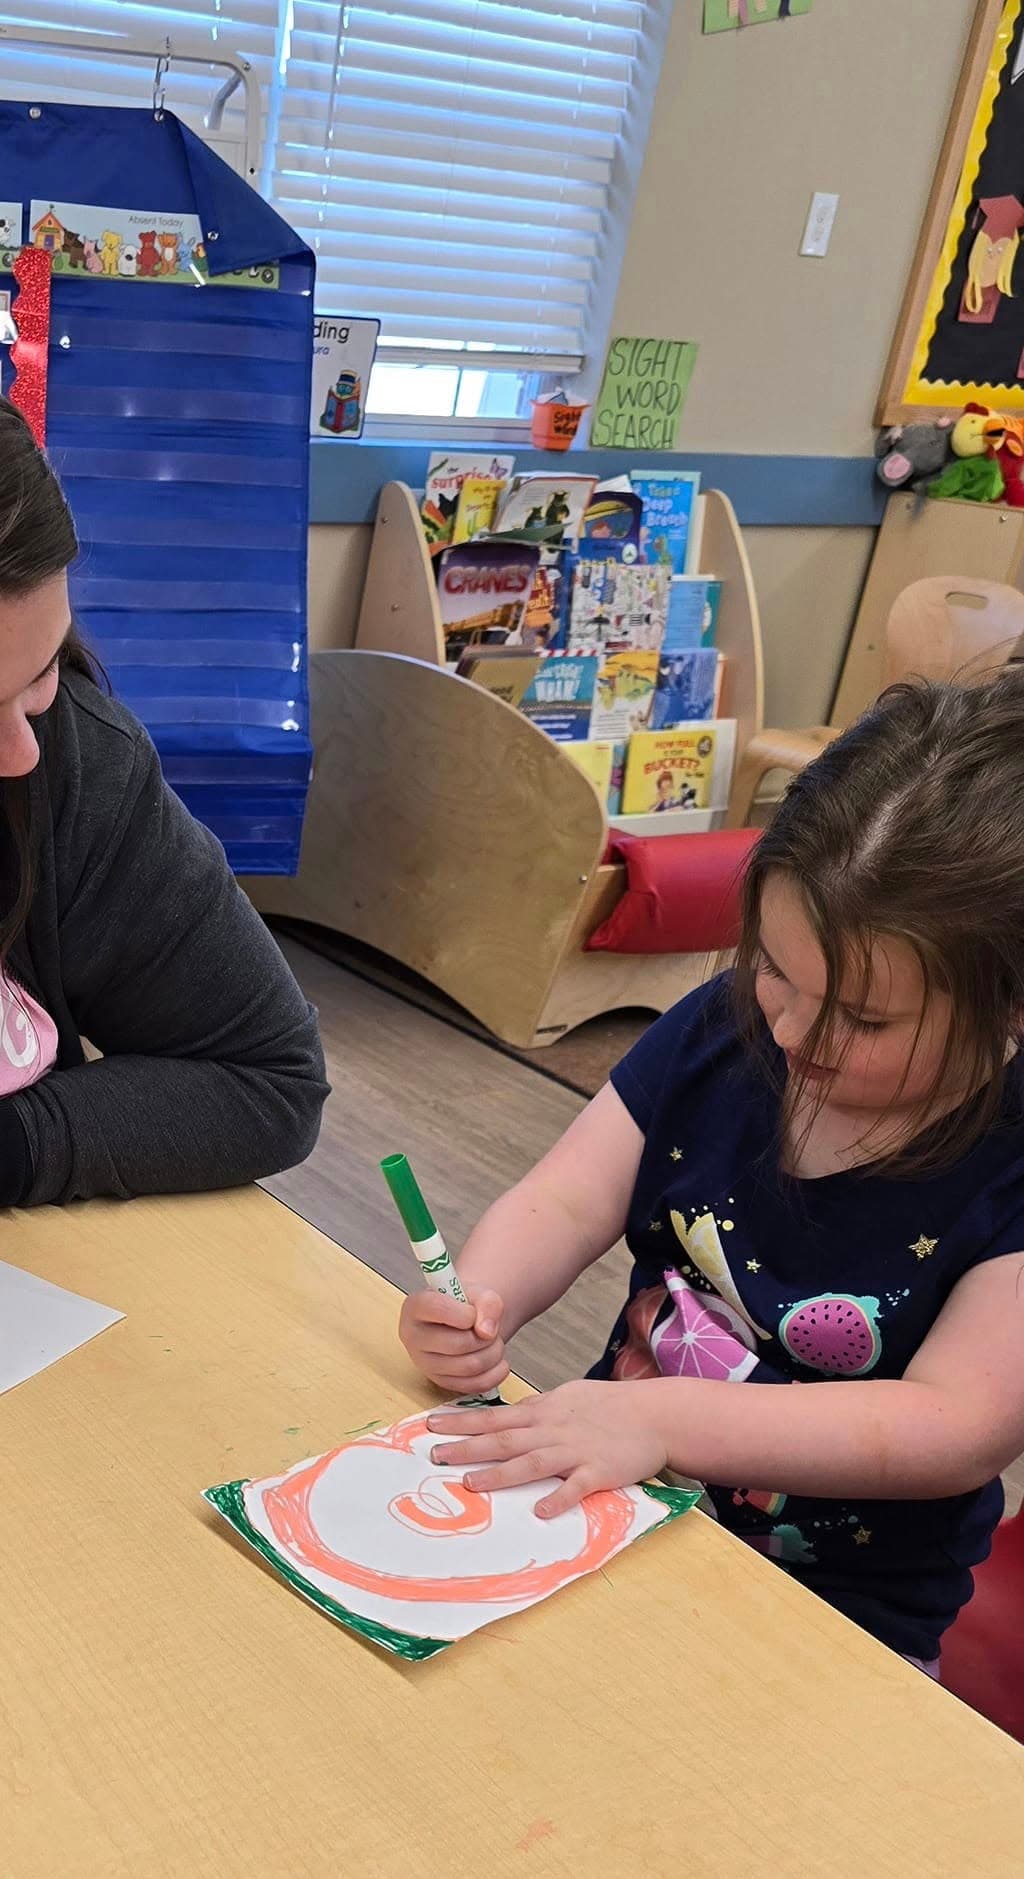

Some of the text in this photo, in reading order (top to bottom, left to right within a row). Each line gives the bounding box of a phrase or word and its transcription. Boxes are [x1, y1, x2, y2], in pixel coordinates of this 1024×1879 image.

[128, 215, 184, 228] Absent Today
[608, 337, 689, 378] SIGHT
[616, 379, 682, 417] WORD
[593, 408, 677, 450] SEARCH
[443, 564, 530, 594] CRANES
